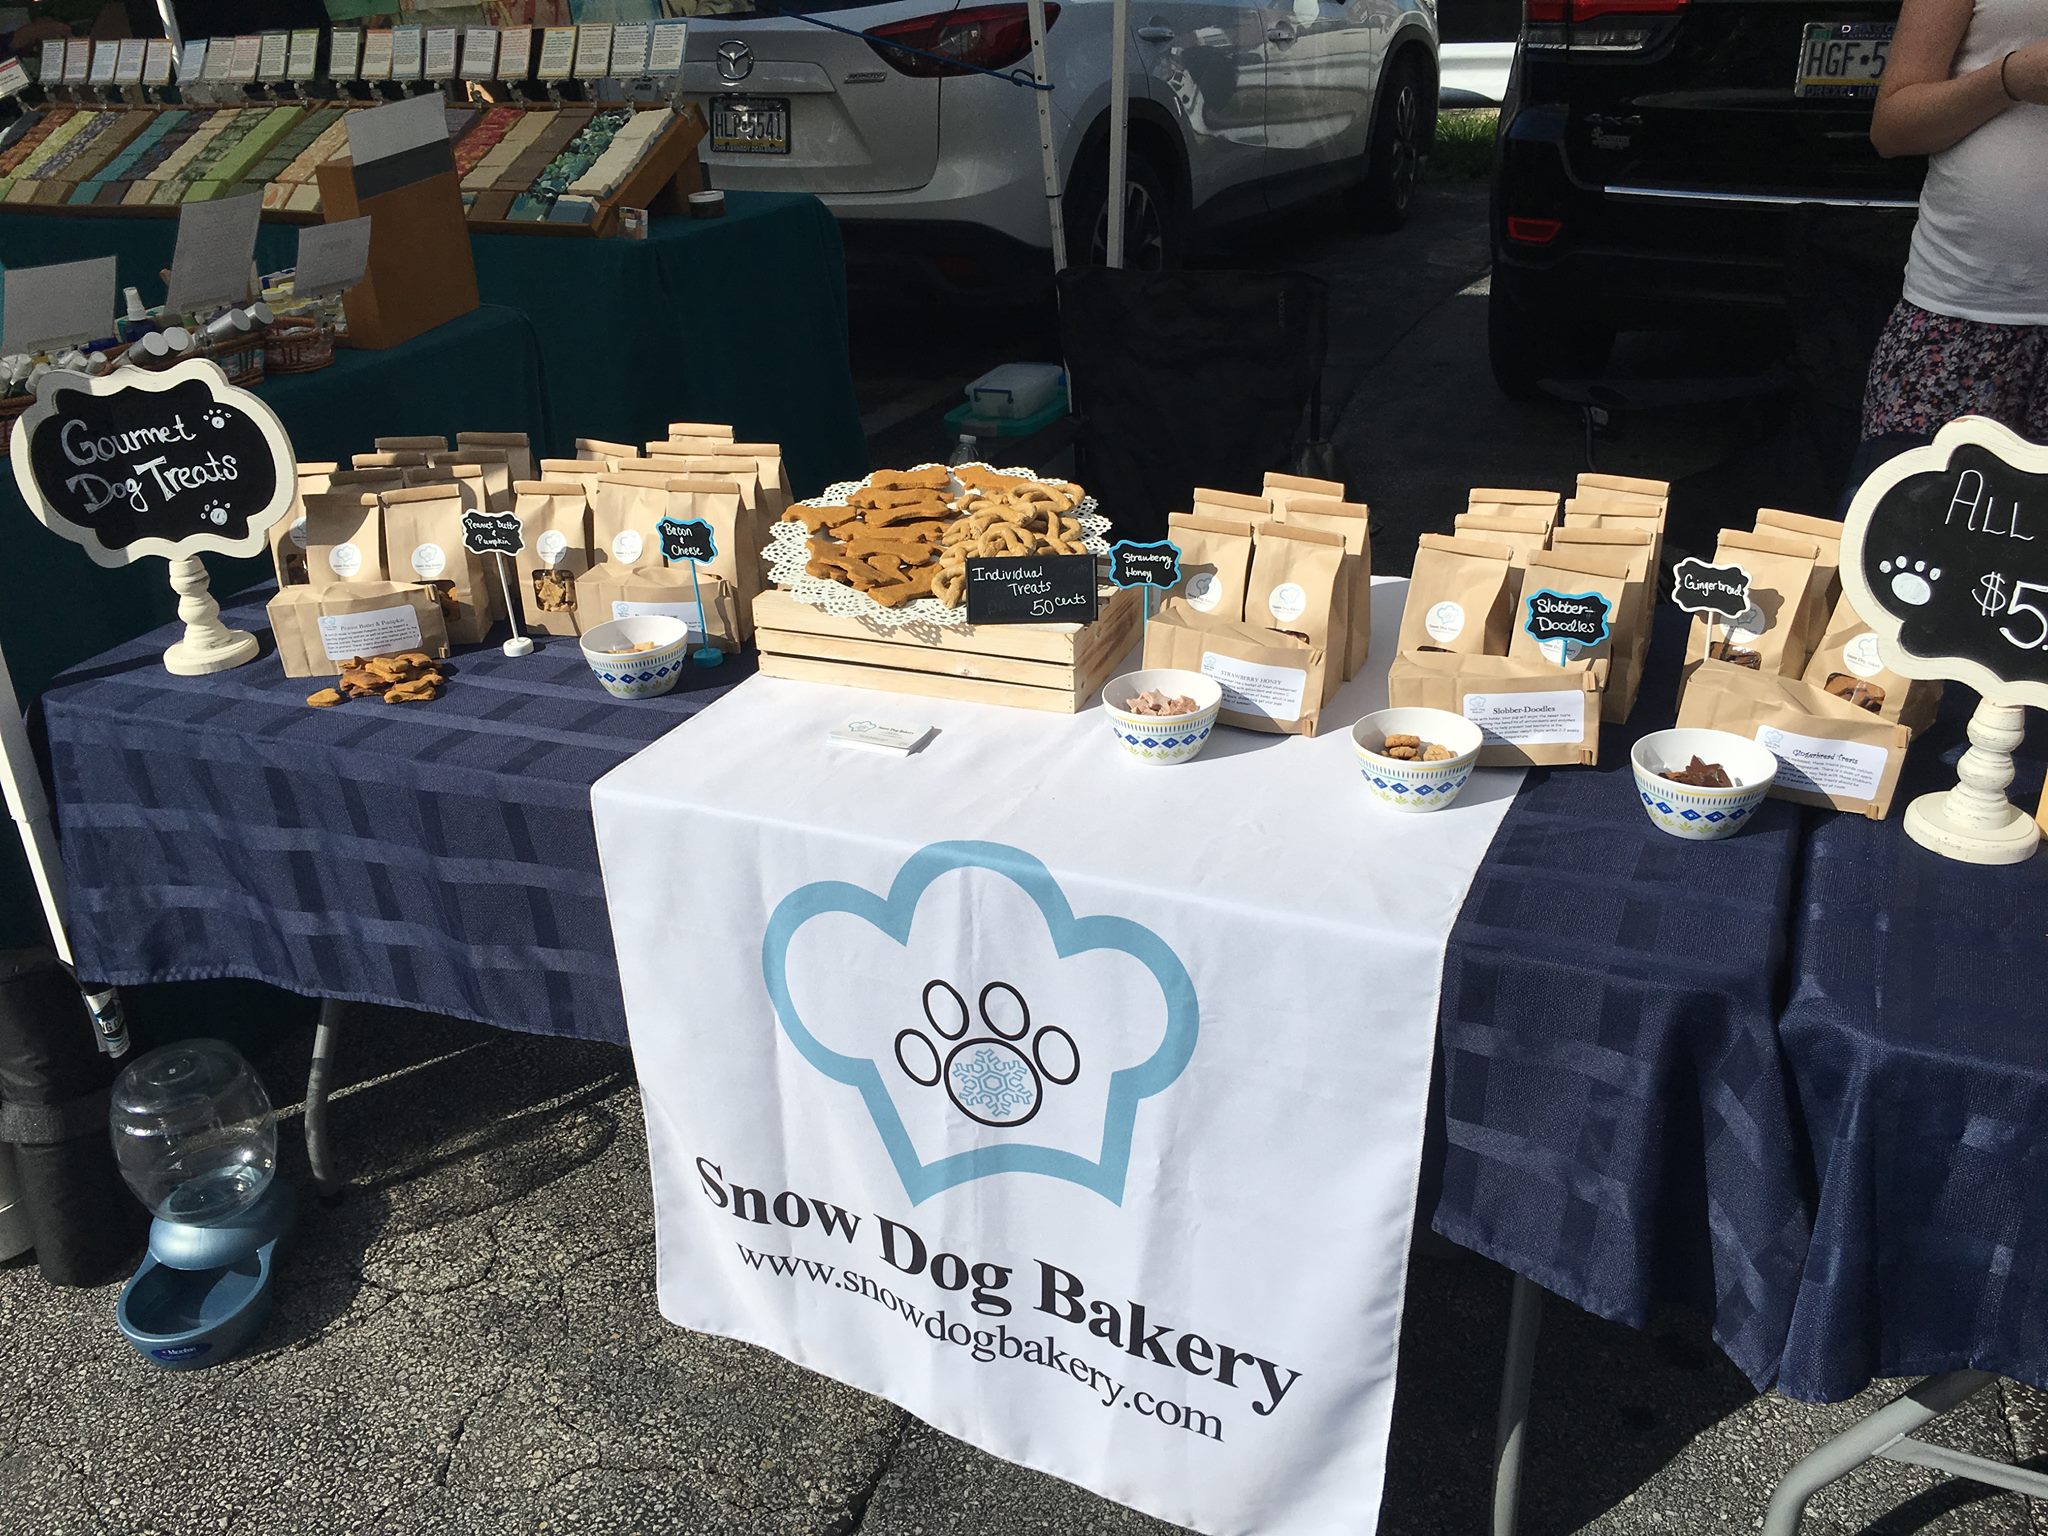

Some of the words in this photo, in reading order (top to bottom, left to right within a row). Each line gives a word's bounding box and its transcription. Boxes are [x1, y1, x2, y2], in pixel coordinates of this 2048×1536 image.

[60, 414, 197, 467] Gourmet
[65, 472, 149, 513] Dog
[133, 451, 238, 501] Treats
[1944, 469, 2035, 541] ALL
[464, 518, 494, 530] Peanut
[662, 522, 693, 537] Bacon
[475, 534, 512, 547] Pumpkin
[671, 544, 704, 556] Cheese
[971, 566, 1044, 582] Individual
[1125, 566, 1153, 583] Honey
[1007, 580, 1052, 598] Treats
[1683, 574, 1745, 597] Gingerbread
[1029, 599, 1055, 616] 50
[1054, 593, 1087, 607] cents
[1536, 616, 1596, 634] Doodles
[1221, 669, 1259, 683] STRAWBERRY
[1259, 677, 1282, 685] HONEY
[1492, 705, 1556, 715] Slobber-Doodles
[1792, 749, 1835, 760] Gingerbread
[1837, 753, 1859, 765] Treats
[695, 1156, 863, 1244] Snow
[873, 1212, 1014, 1317] Dog
[1032, 1257, 1303, 1416] Bakery
[735, 1241, 1226, 1443] www.snowdogbakery.com
